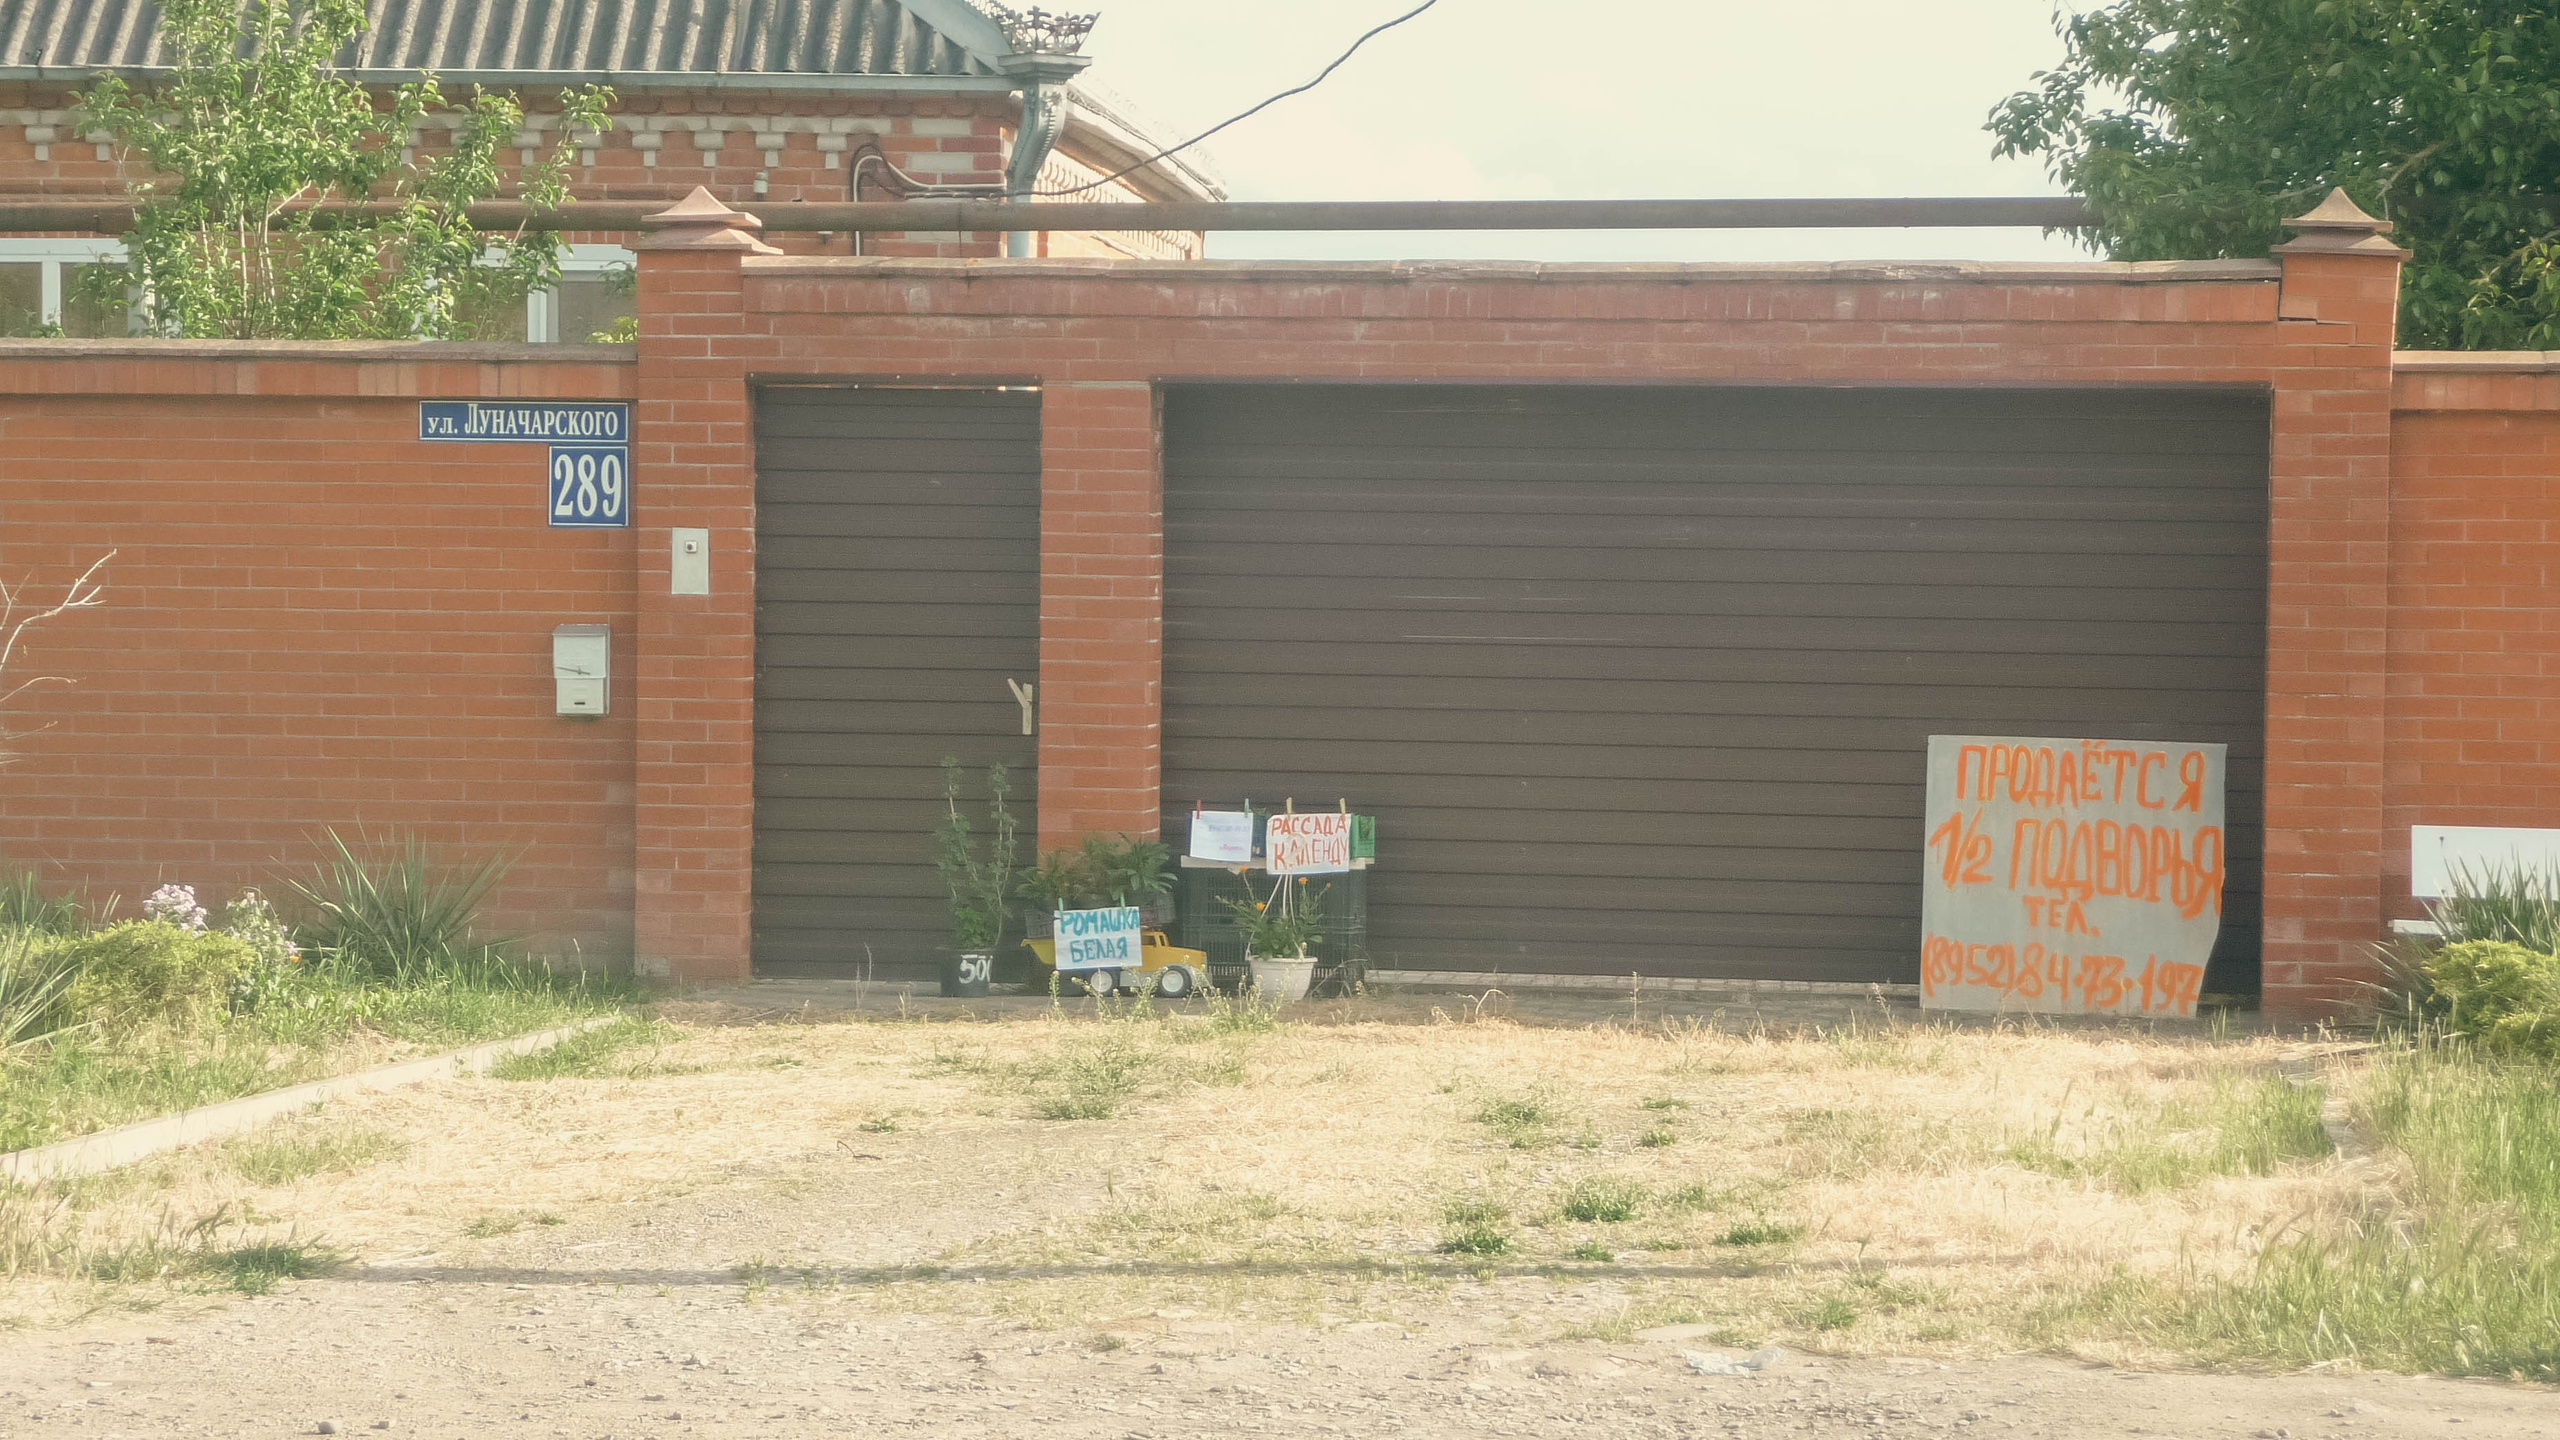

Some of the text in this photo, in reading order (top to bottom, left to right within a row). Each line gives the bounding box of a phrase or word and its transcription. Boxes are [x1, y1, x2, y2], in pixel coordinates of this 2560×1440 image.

[427, 417, 458, 434] ул.
[554, 454, 622, 517] 289
[1271, 815, 1348, 837] РАССАДА
[1928, 807, 2224, 919] 1/2 ПОДВОРЬЯ
[1059, 907, 1140, 936] РОМАШКА
[2023, 896, 2101, 937] ТЕЛ.
[1069, 936, 1129, 963] БЕЛАЯ
